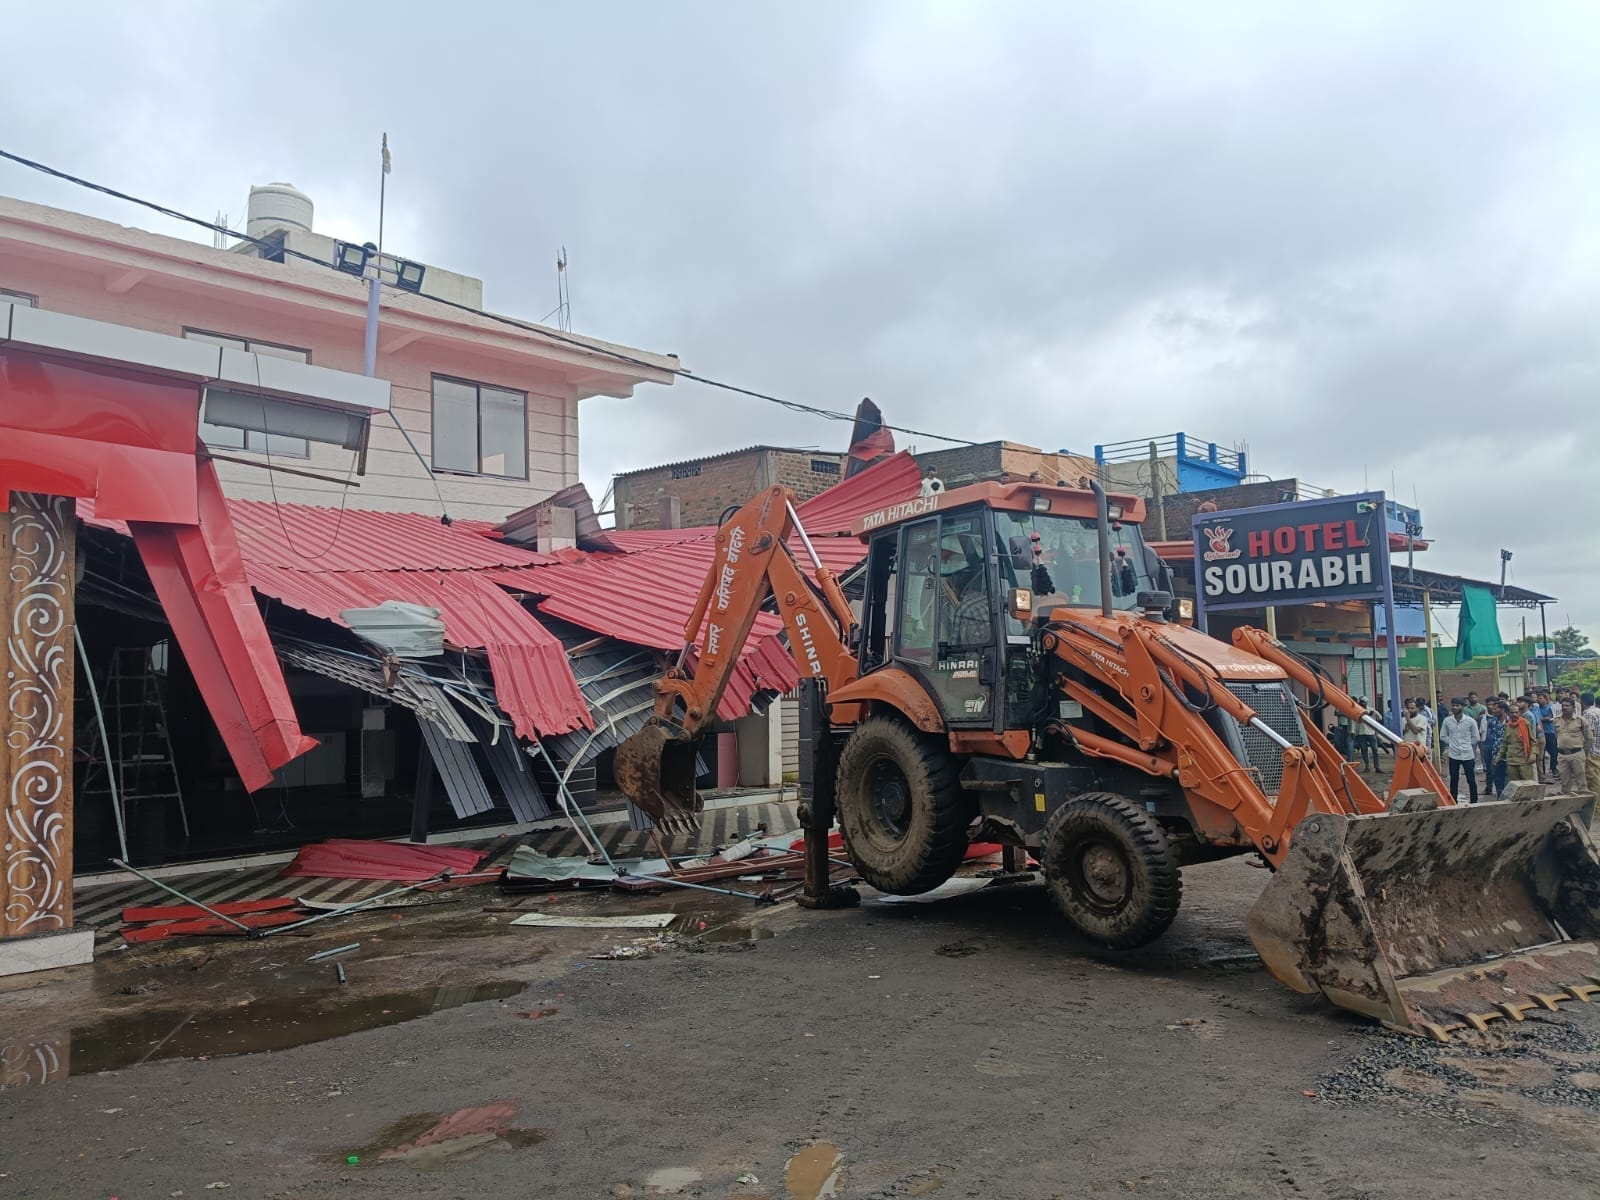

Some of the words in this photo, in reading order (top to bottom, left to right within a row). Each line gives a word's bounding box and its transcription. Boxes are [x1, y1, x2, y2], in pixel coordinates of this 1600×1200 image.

[863, 511, 885, 530] TATA
[887, 495, 938, 520] HITACHI
[1248, 520, 1367, 558] HOTEL
[1205, 553, 1372, 596] SOURABH
[708, 623, 724, 654] नगर
[795, 613, 824, 678] SHINR
[938, 660, 978, 670] HINRAI
[1090, 650, 1105, 663] TATA
[1105, 659, 1129, 677] HITACH
